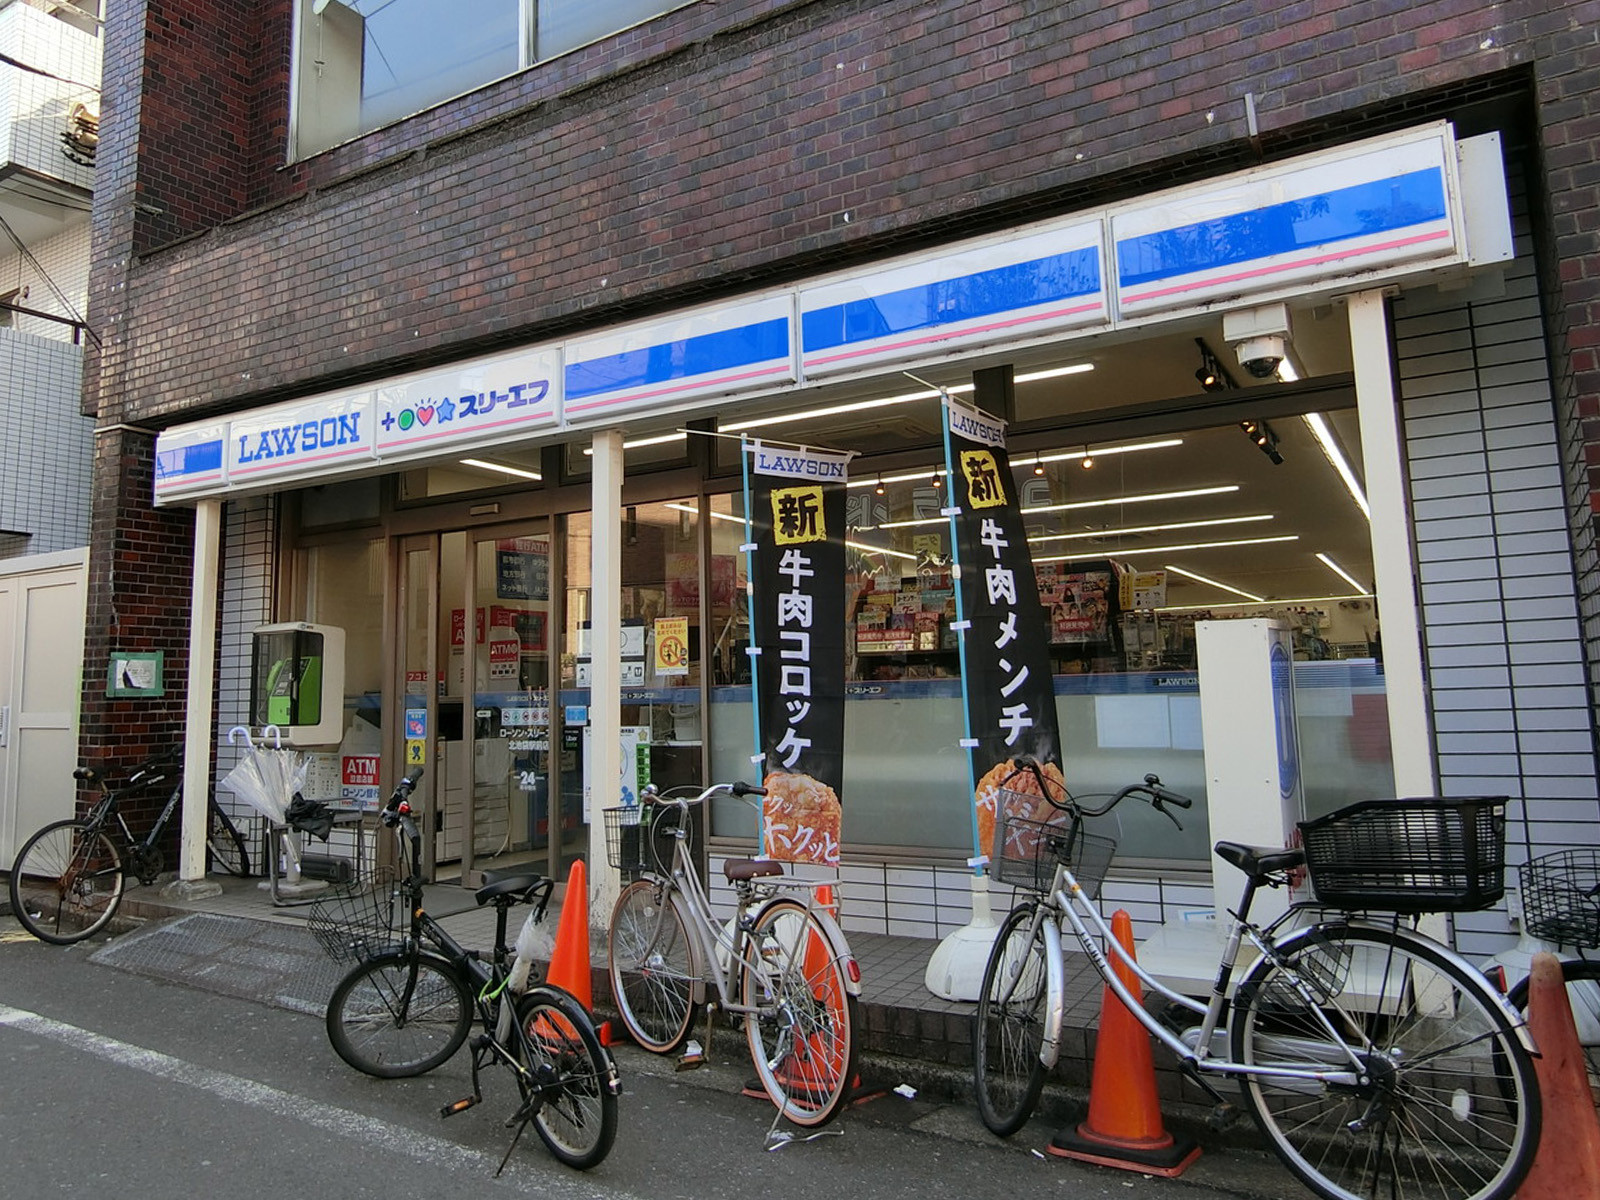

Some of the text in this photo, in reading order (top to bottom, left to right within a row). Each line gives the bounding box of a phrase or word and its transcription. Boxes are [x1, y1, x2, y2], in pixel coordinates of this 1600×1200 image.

[459, 379, 549, 417] スリーエフ
[238, 411, 361, 464] LAWSON
[952, 411, 1004, 442] LAWSON
[759, 453, 845, 478] LAWSON
[965, 456, 1002, 502] 新
[777, 492, 820, 538] 新
[981, 518, 1034, 747] 牛肉メンチ
[776, 549, 815, 769] 牛肉コロッケ
[347, 759, 377, 775] ATM
[521, 771, 535, 785] 24
